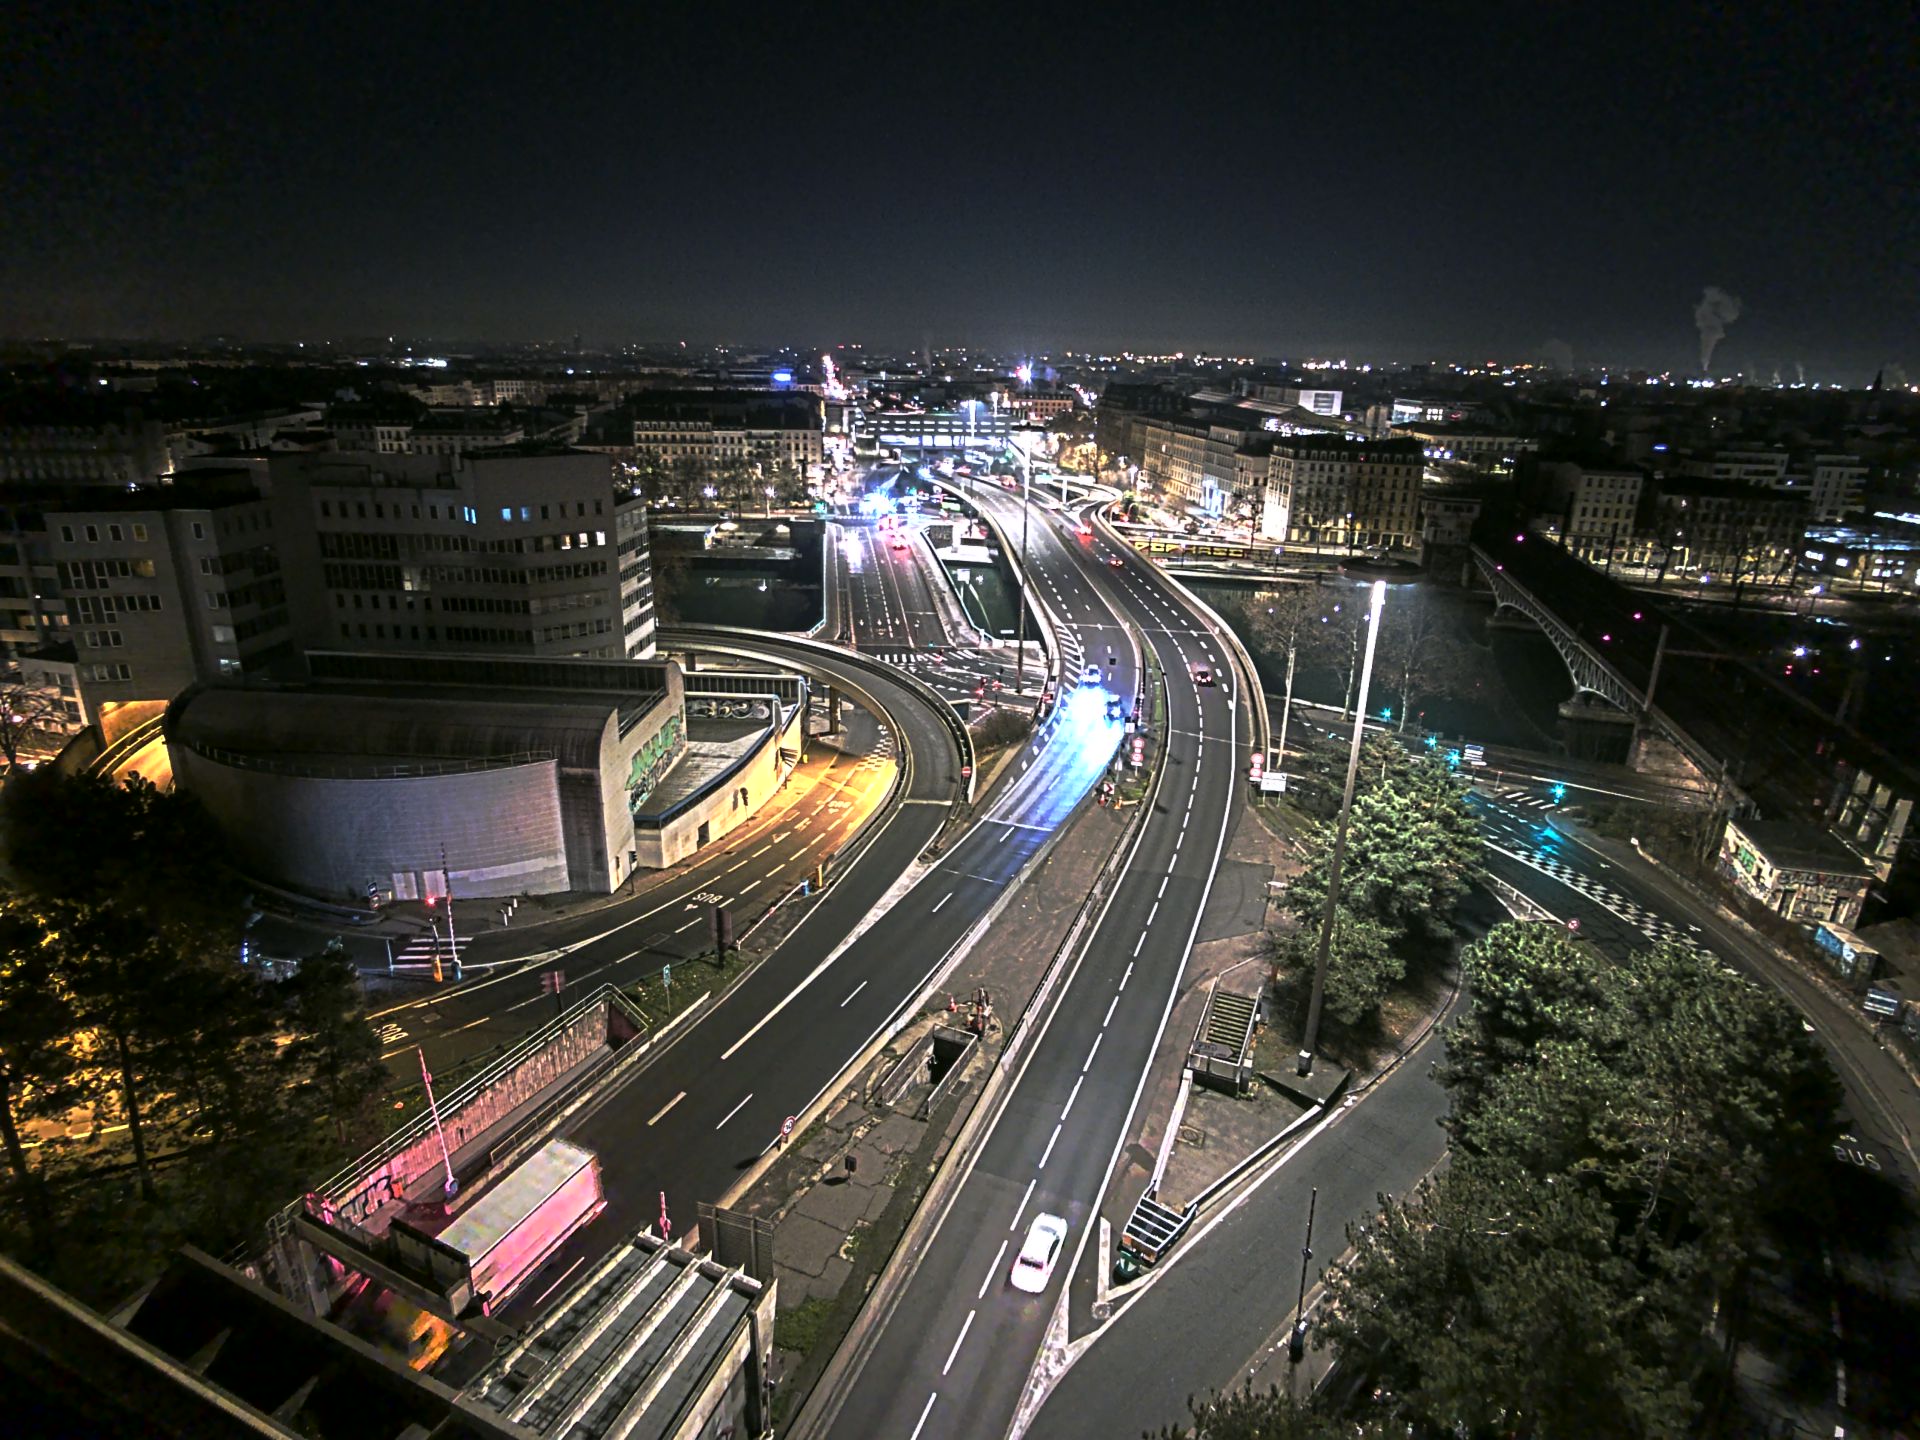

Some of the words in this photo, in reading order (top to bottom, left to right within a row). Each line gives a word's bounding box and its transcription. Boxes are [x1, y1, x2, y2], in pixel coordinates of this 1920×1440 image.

[692, 892, 723, 904] BUS
[381, 1023, 409, 1044] BUS
[1831, 1144, 1882, 1171] BUS
